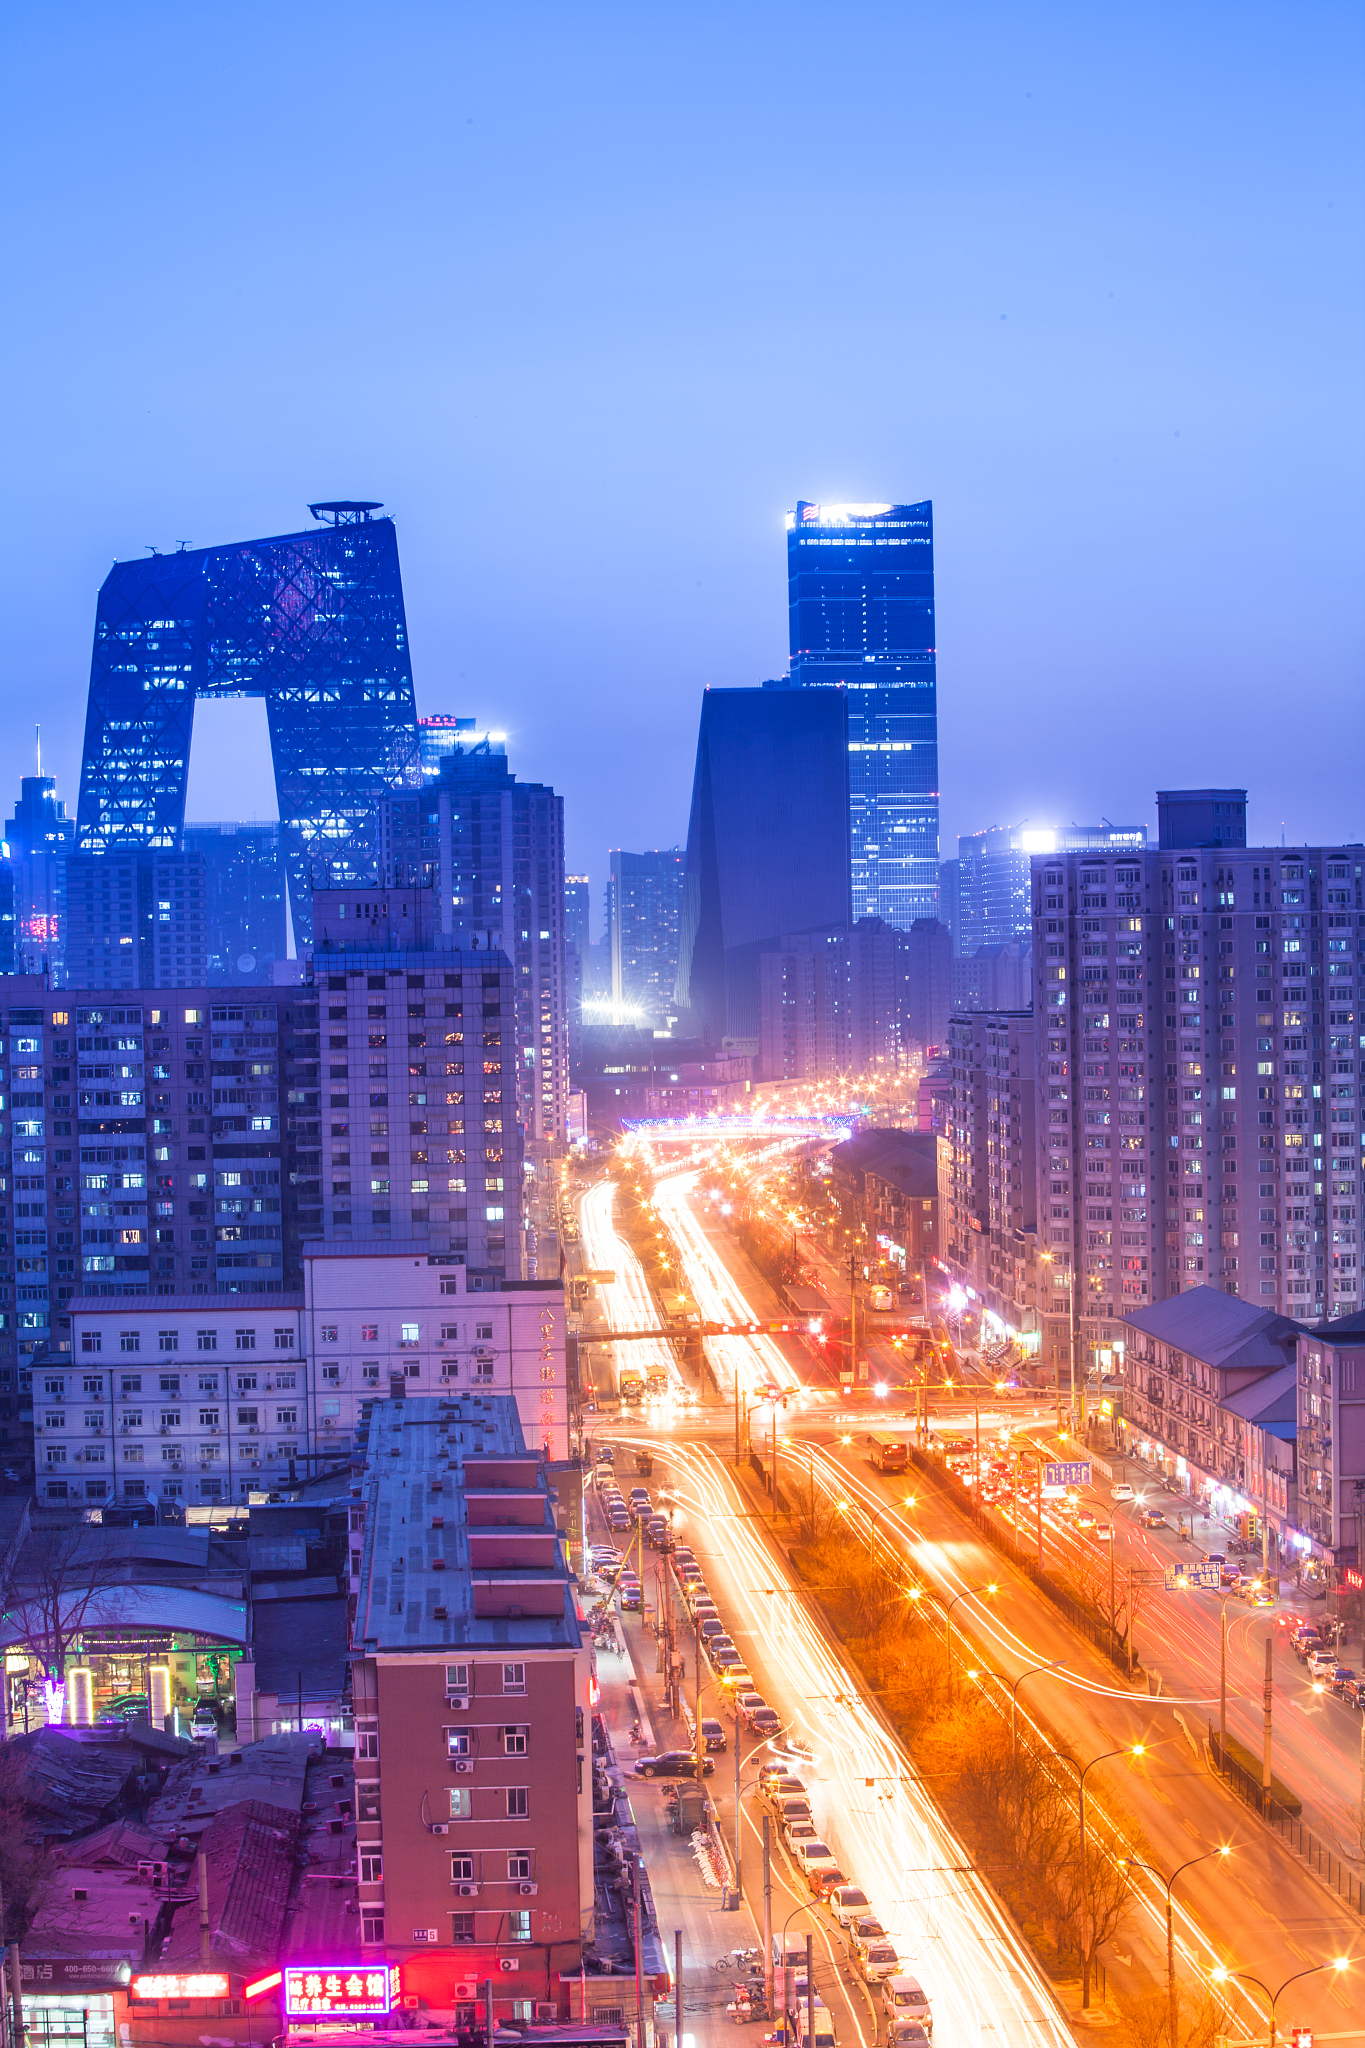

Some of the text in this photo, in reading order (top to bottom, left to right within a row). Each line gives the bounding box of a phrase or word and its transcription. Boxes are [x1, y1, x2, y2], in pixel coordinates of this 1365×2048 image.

[429, 1931, 435, 1940] 5
[305, 1974, 384, 1997] 养生会馆
[291, 1997, 310, 2010] 足疗
[311, 1997, 331, 2010] 推拿
